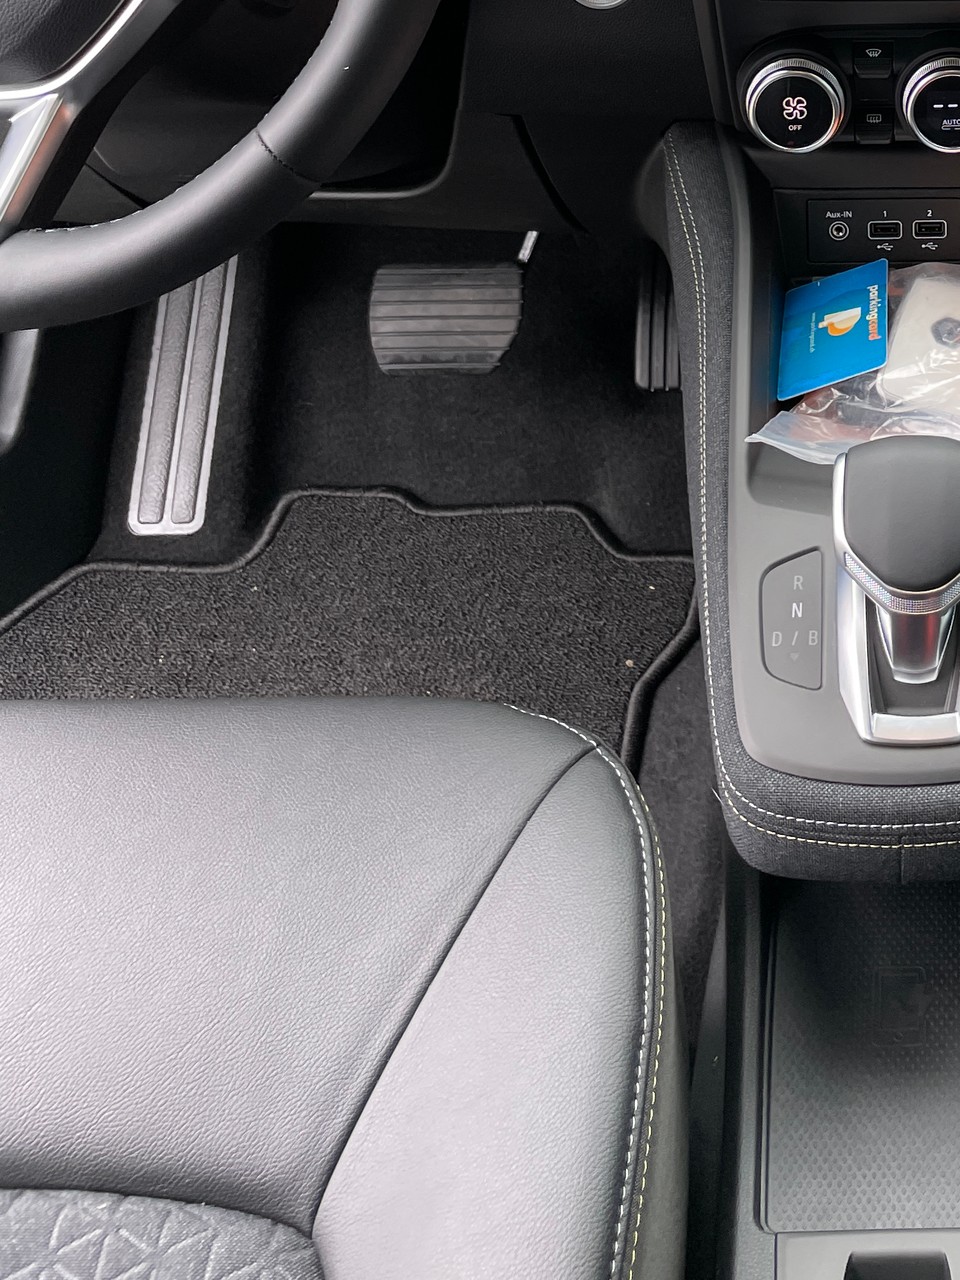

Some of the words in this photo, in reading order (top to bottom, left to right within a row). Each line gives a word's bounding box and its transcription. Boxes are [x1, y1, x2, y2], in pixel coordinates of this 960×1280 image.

[788, 123, 802, 131] OFF
[825, 210, 853, 219] Aux-IN
[926, 209, 933, 218] 2
[865, 284, 882, 340] parkingcard
[793, 575, 804, 590] R
[791, 602, 803, 617] N
[771, 631, 783, 646] D
[808, 631, 819, 646] B
